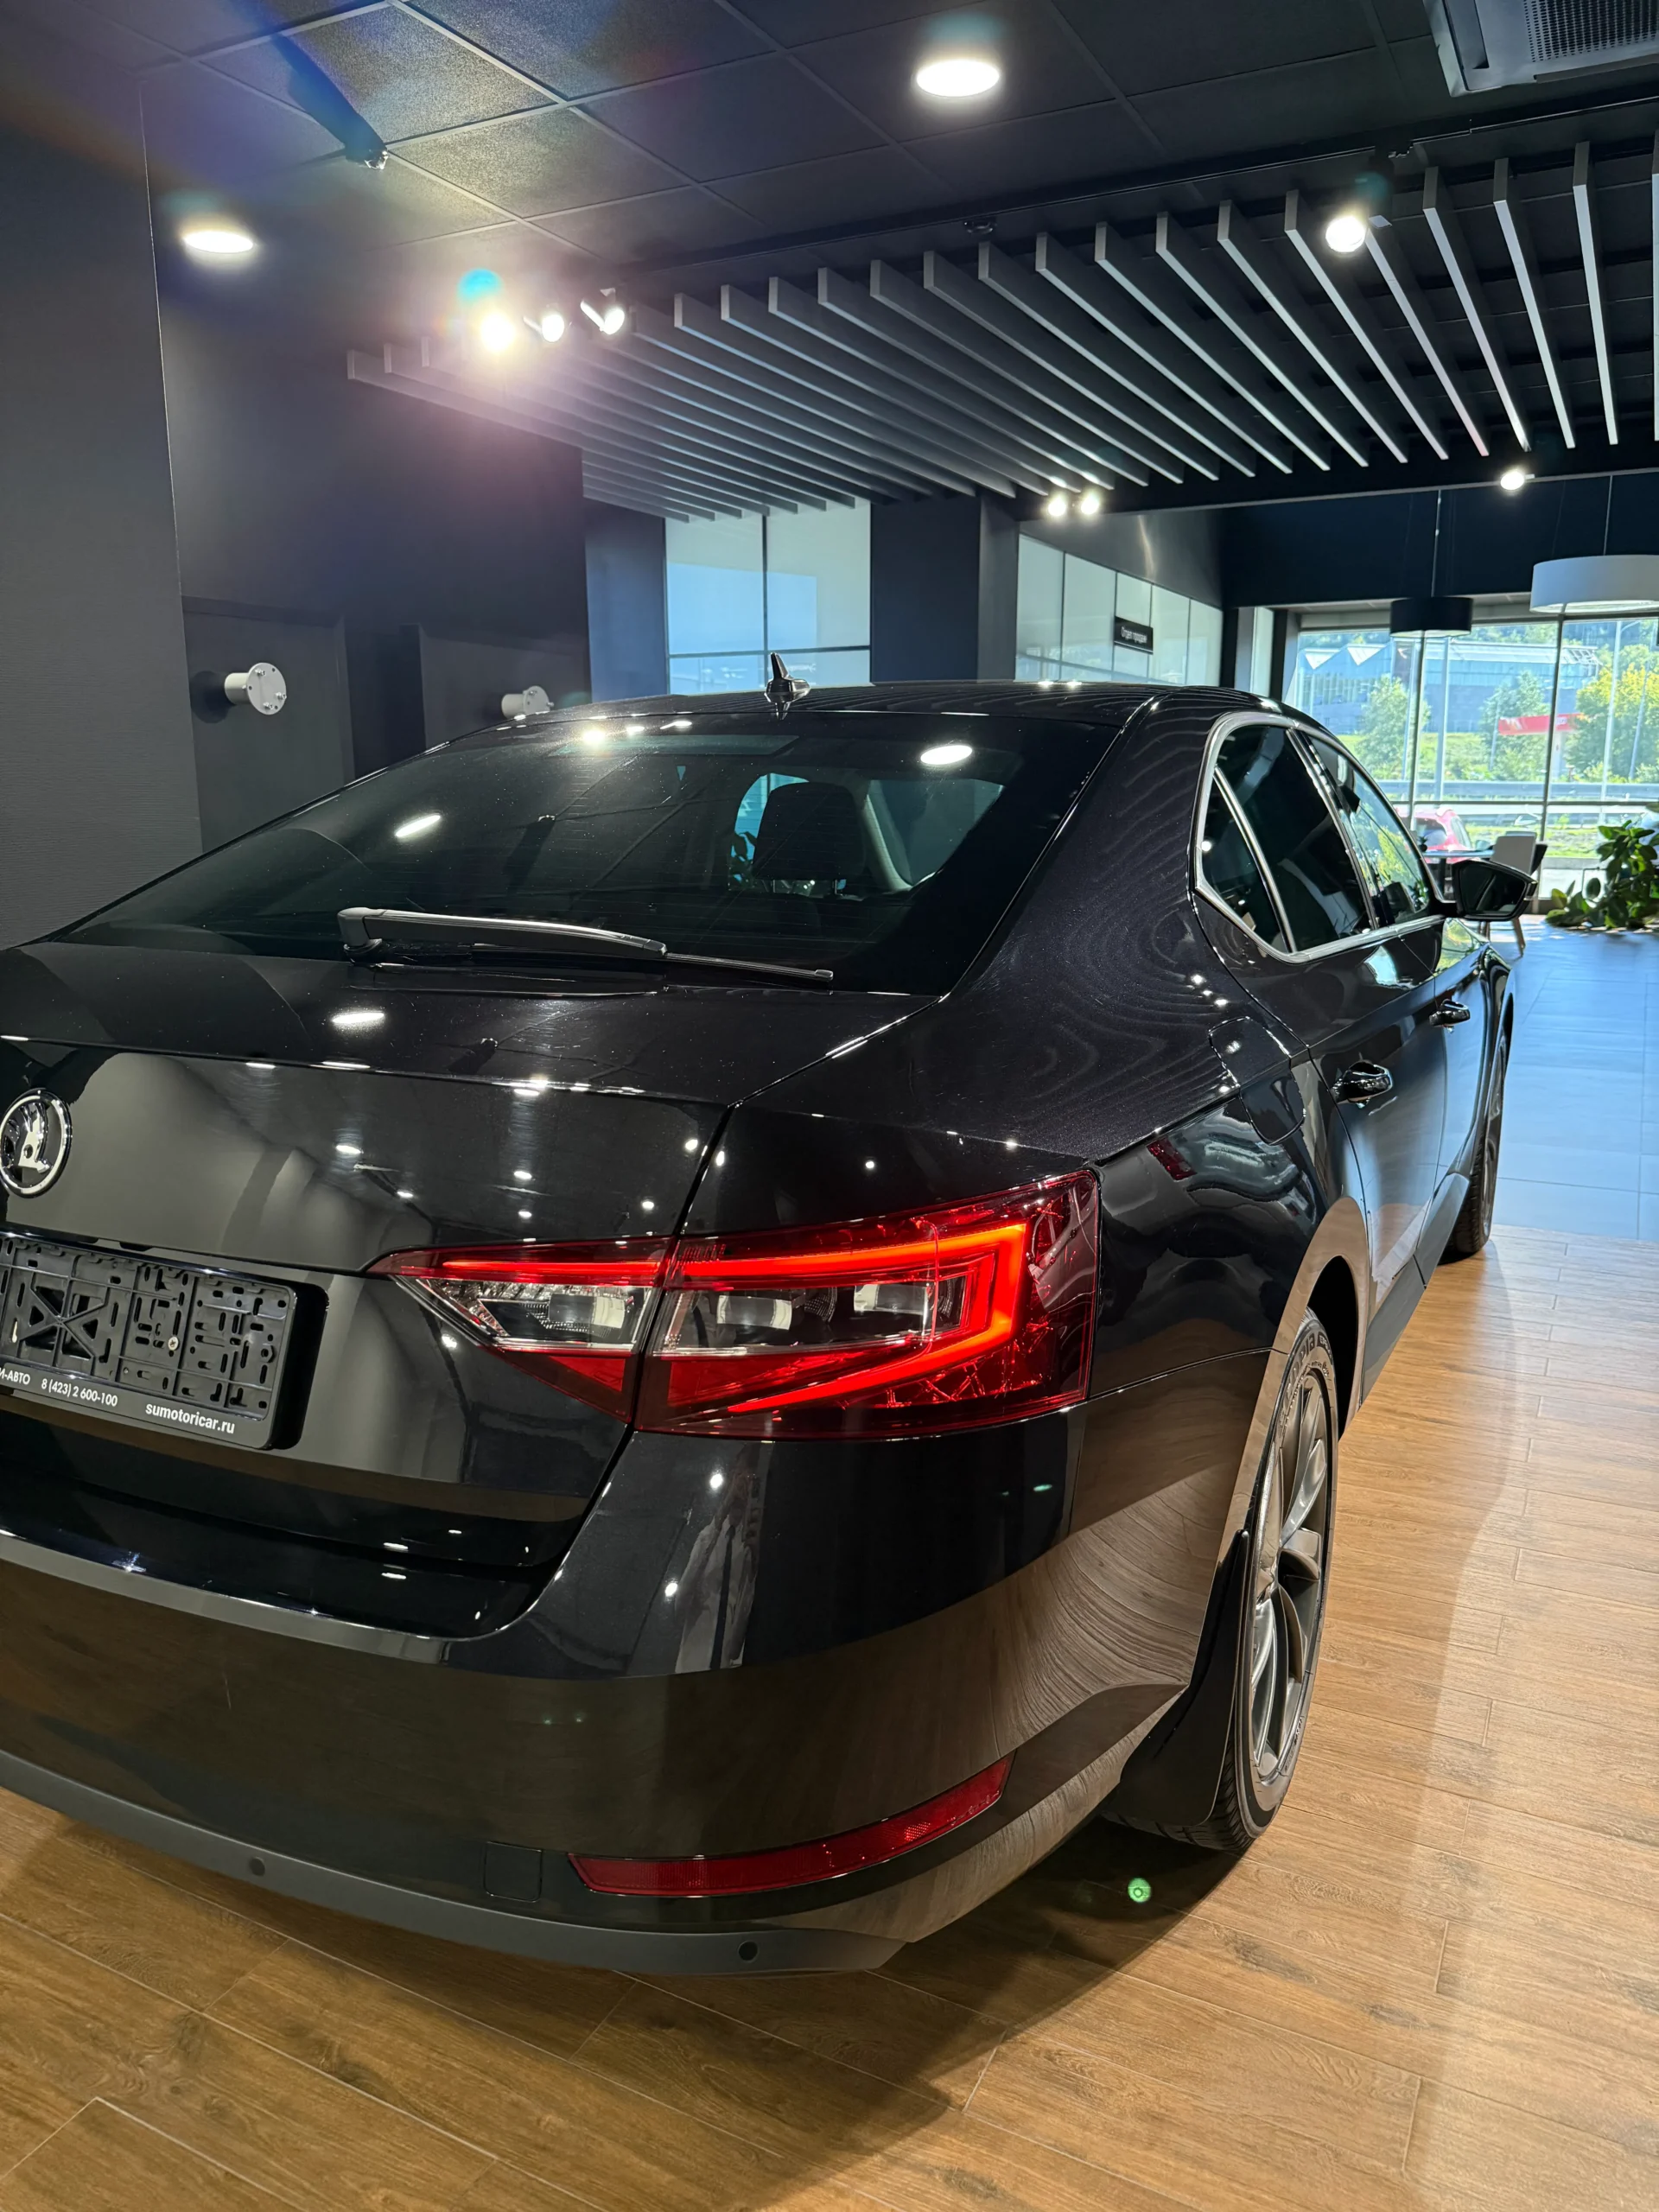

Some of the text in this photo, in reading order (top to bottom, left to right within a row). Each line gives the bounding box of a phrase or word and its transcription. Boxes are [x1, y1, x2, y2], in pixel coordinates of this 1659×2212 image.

[41, 1378, 48, 1389] 8
[48, 1379, 72, 1397] (423)
[72, 1386, 79, 1397] 2
[79, 1388, 118, 1407] 600-100
[145, 1403, 236, 1434] sumotoricar.ru
